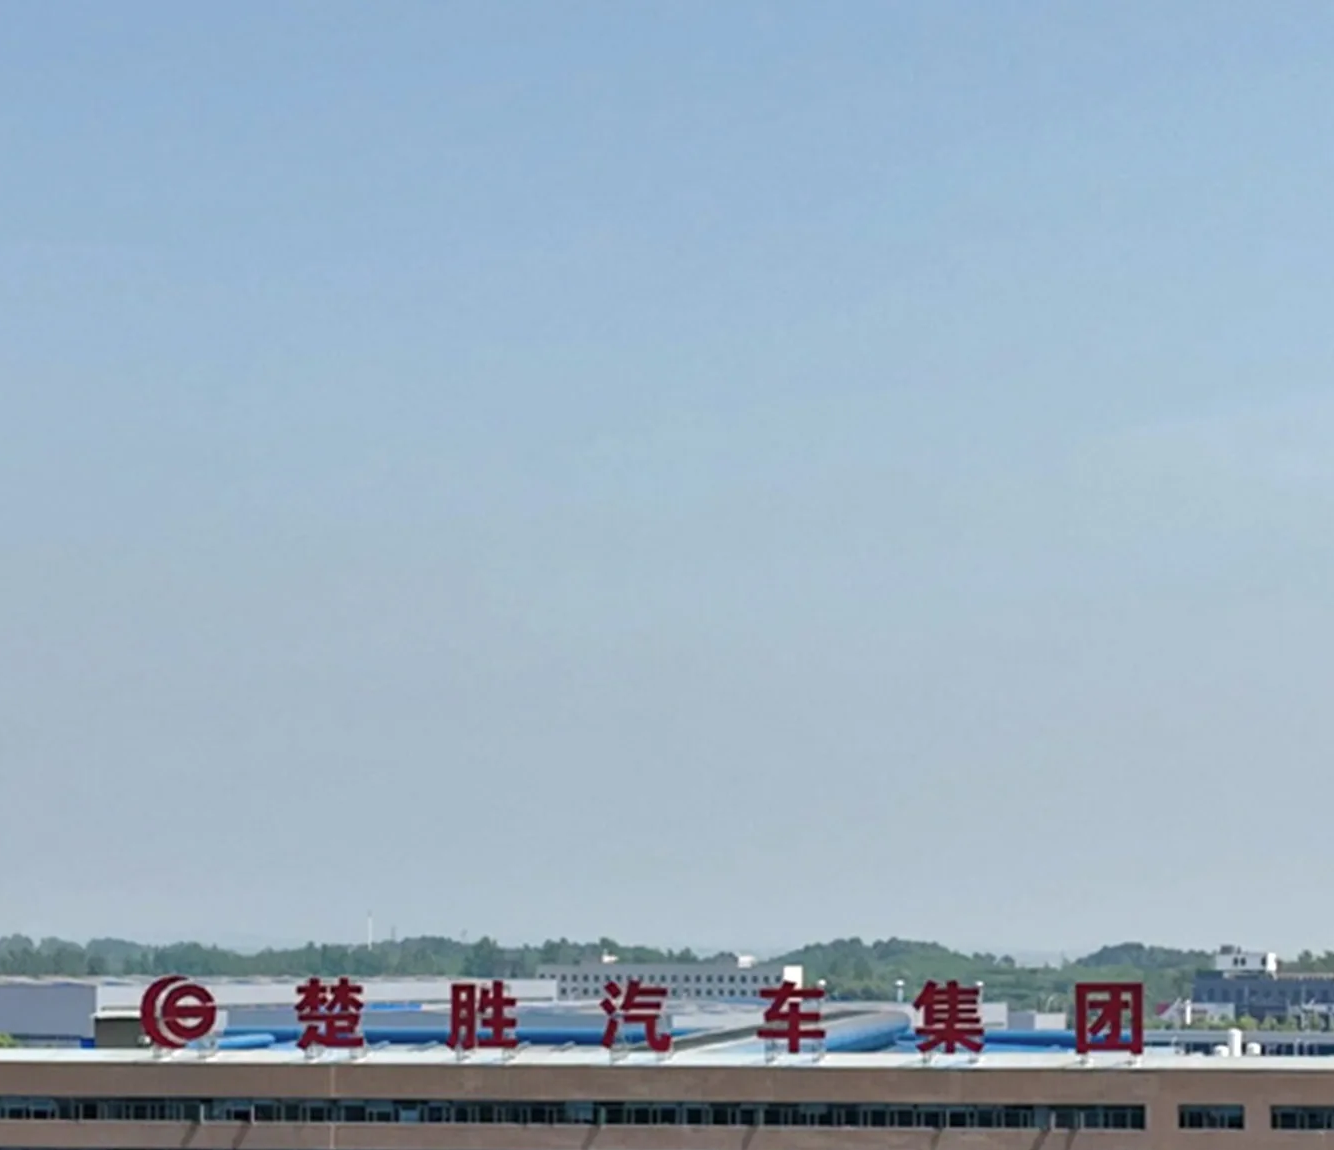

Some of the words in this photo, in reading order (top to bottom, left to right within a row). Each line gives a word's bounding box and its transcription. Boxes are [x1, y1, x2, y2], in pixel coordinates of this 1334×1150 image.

[295, 977, 1145, 1053] 楚胜汽车集团
